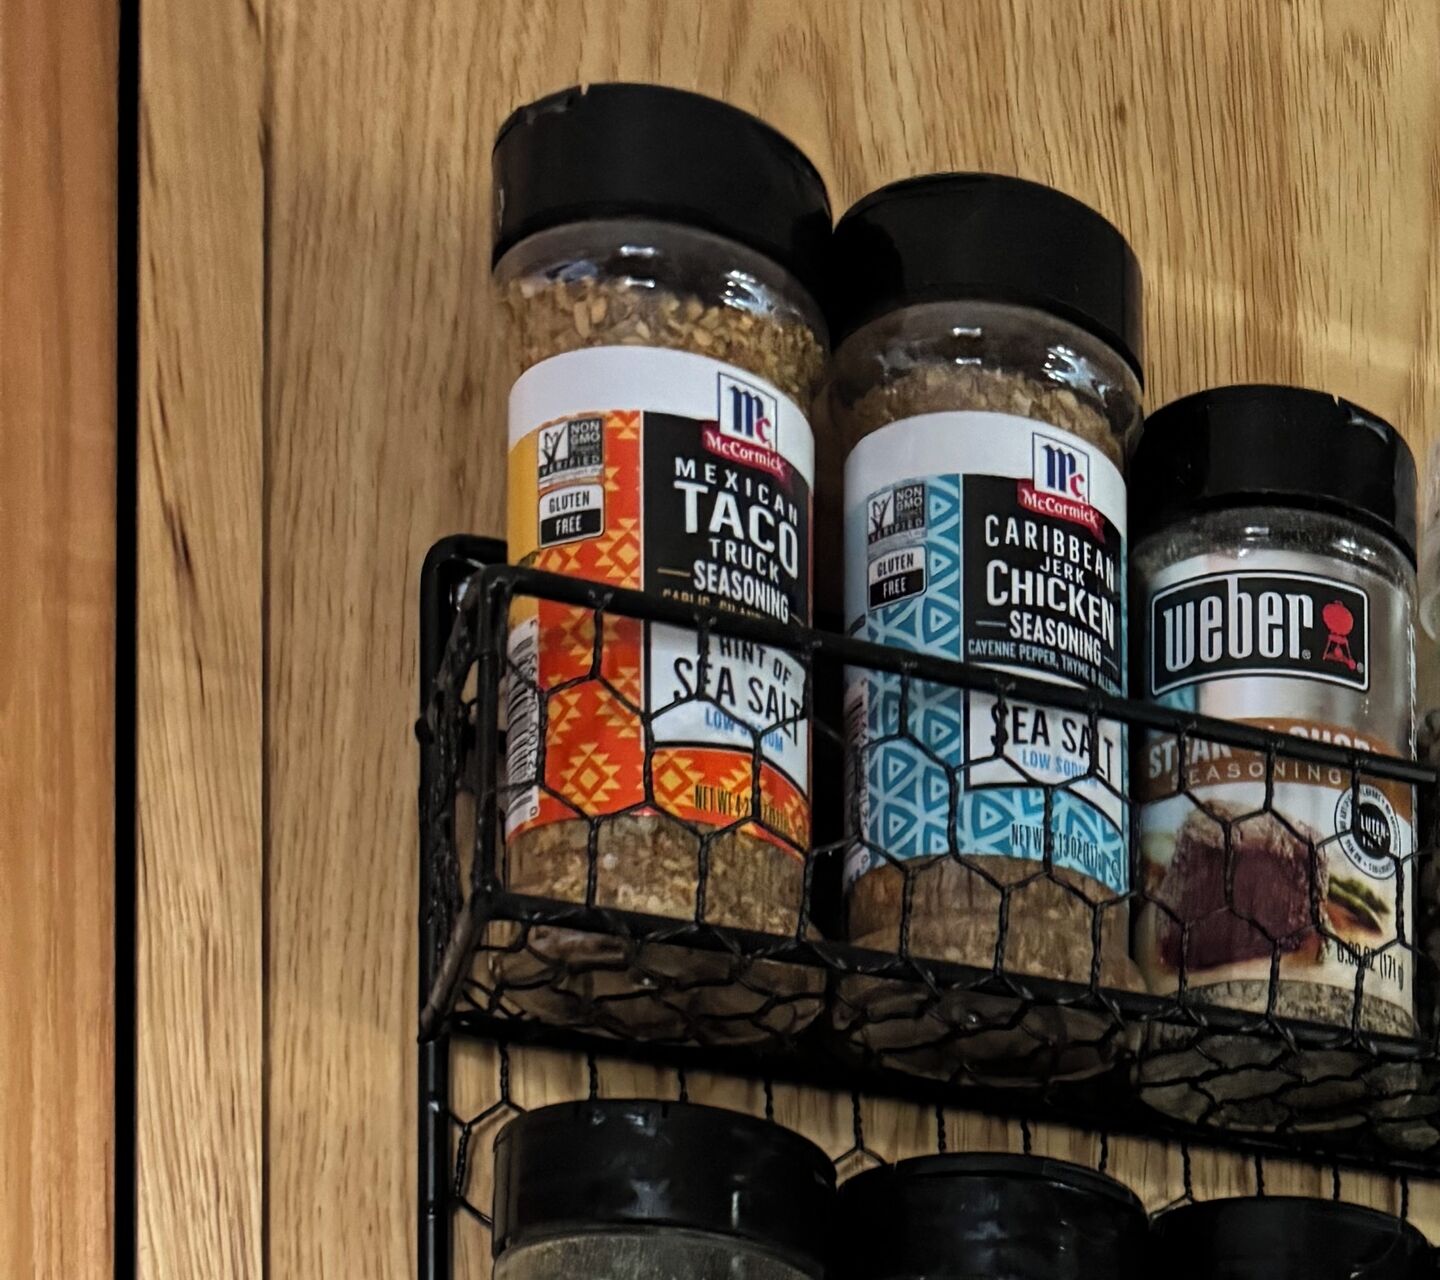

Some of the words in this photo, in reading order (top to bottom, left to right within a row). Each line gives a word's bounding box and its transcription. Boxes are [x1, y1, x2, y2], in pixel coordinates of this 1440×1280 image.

[571, 421, 600, 436] NON
[571, 431, 600, 445] GMO
[704, 430, 785, 476] McCormick
[549, 490, 590, 514] GLUTEN
[674, 456, 799, 528] MEXICAN
[896, 486, 924, 500] NON
[896, 496, 924, 512] GMO
[1022, 491, 1098, 527] McCormick
[555, 514, 582, 536] FREE
[673, 479, 799, 580] TACO
[709, 538, 780, 585] TRUCK
[877, 553, 914, 577] GLUTEN
[985, 515, 1115, 594] CARIBBEAN
[1040, 556, 1085, 586] JERK
[693, 560, 789, 625] SEASONING
[883, 576, 907, 600] FREE
[986, 559, 1115, 650] CHICKEN
[1009, 610, 1102, 667] SEASONING
[1163, 577, 1314, 673] weber
[719, 635, 767, 669] HINT
[773, 656, 792, 685] OF
[968, 639, 1016, 659] CAYENNE
[1019, 642, 1060, 670] PEPPER,
[1061, 651, 1090, 679] THYME
[704, 707, 734, 730] LOW
[748, 676, 801, 747] SALT
[1022, 749, 1050, 770] LOW
